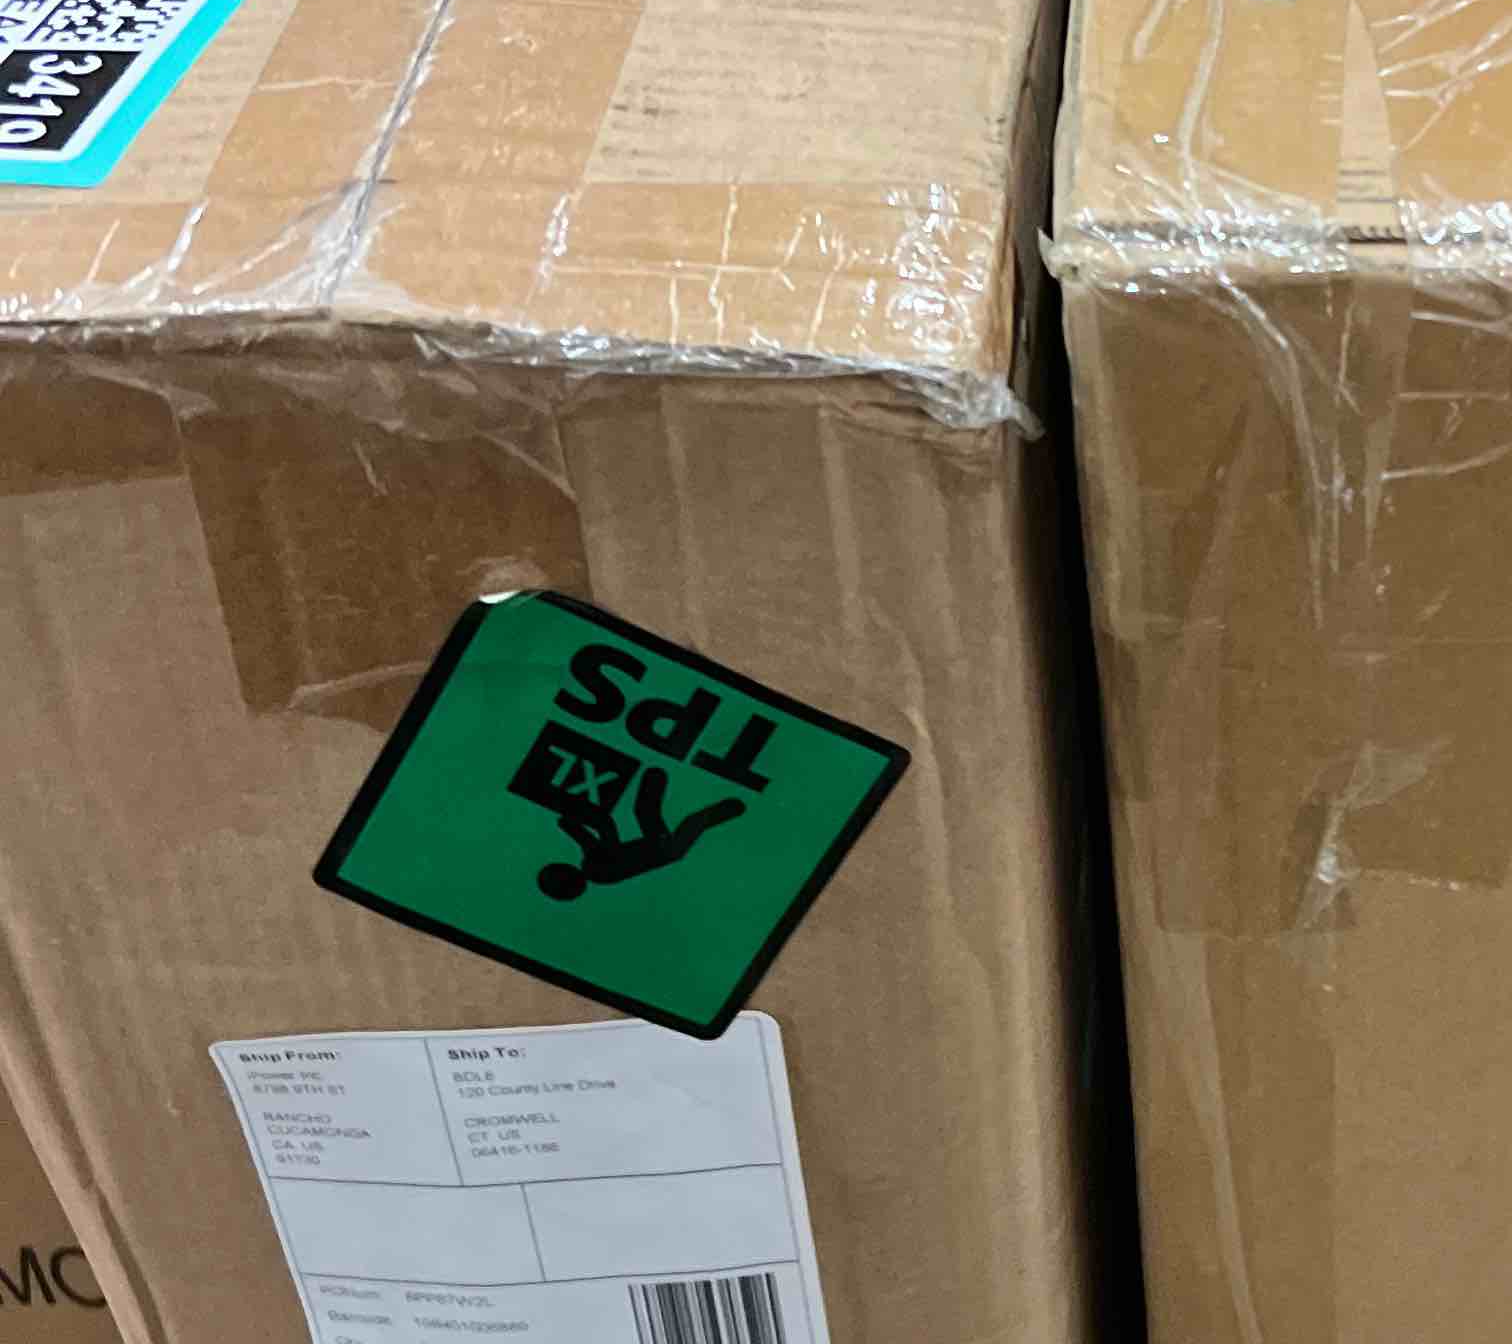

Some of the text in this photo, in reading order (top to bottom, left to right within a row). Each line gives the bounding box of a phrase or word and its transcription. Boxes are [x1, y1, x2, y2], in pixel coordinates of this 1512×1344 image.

[553, 643, 779, 793] TPS
[546, 743, 620, 805] XL
[448, 1047, 527, 1061] Ship To:
